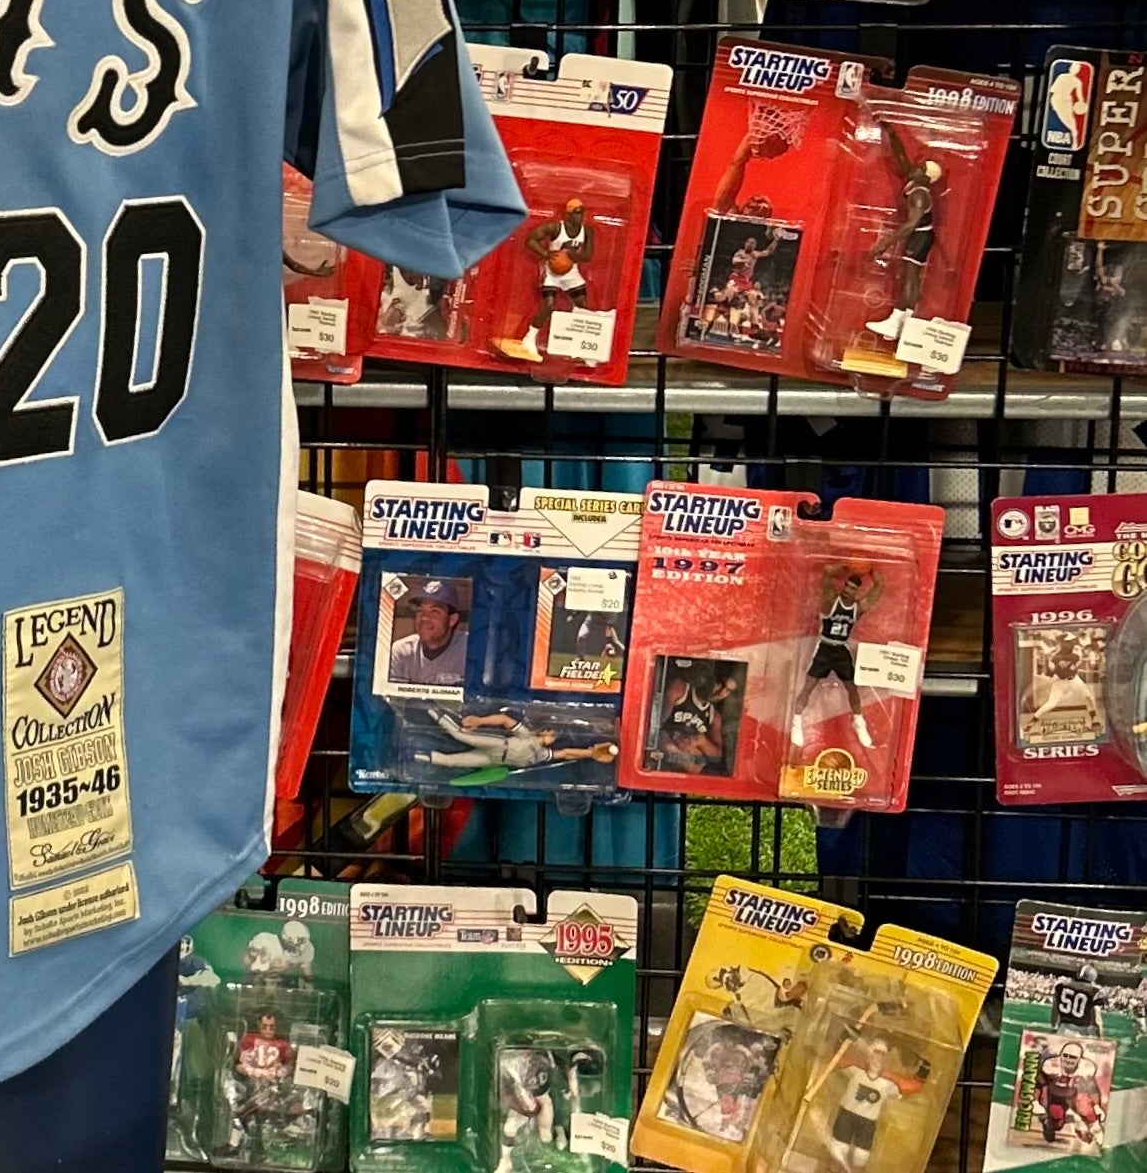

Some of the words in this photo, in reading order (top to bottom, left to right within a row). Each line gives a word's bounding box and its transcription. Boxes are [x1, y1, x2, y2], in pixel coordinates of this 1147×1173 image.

[732, 47, 829, 78] STARTING
[743, 67, 813, 92] LINEUP
[611, 90, 638, 110] 50
[974, 93, 1015, 115] EDITION
[1046, 130, 1072, 145] NBA
[1087, 66, 1144, 219] SUPER
[318, 331, 335, 343] $30
[580, 340, 598, 352] $30
[929, 350, 948, 364] $30
[372, 498, 484, 522] STARTING
[535, 496, 578, 512] SPECIAL
[580, 498, 616, 513] SERIES
[619, 500, 642, 515] CAR
[650, 492, 760, 519] STARTING
[388, 520, 469, 541] LINEUP
[664, 513, 744, 536] LINEUP
[654, 546, 692, 558] 10th
[695, 548, 747, 561] YEAR
[999, 551, 1094, 570] STARTING
[653, 557, 746, 575] 1997
[1013, 568, 1082, 584] LINEUP
[652, 571, 745, 586] EDITION
[601, 599, 620, 611] $20
[1031, 609, 1097, 625] 1996
[15, 598, 116, 668] LEGEND
[830, 621, 850, 636] 21
[570, 660, 600, 670] STAR
[887, 672, 906, 684] $30
[397, 686, 430, 694] ROBERTO
[12, 692, 116, 750] COLLECTION
[14, 750, 56, 788] JOSH
[57, 732, 118, 777] GIBSON
[1023, 743, 1100, 759] SERIES
[805, 766, 867, 788] EXTENDED
[816, 780, 852, 793] SERIES
[15, 764, 121, 817] 1935~46
[279, 896, 320, 918] 1998
[361, 905, 453, 922] STARTING
[726, 889, 817, 926] STARTING
[374, 921, 442, 937] LINEUP
[735, 908, 801, 937] LINEUP
[1034, 915, 1131, 941] STARTING
[555, 923, 614, 957] 1995
[1046, 933, 1117, 954] LINEUP
[559, 956, 608, 967] EDITION
[893, 944, 937, 970] 1998
[937, 960, 976, 983] EDITION
[1058, 989, 1088, 1019] 50
[257, 1045, 280, 1067] 12
[324, 1076, 341, 1088] $20
